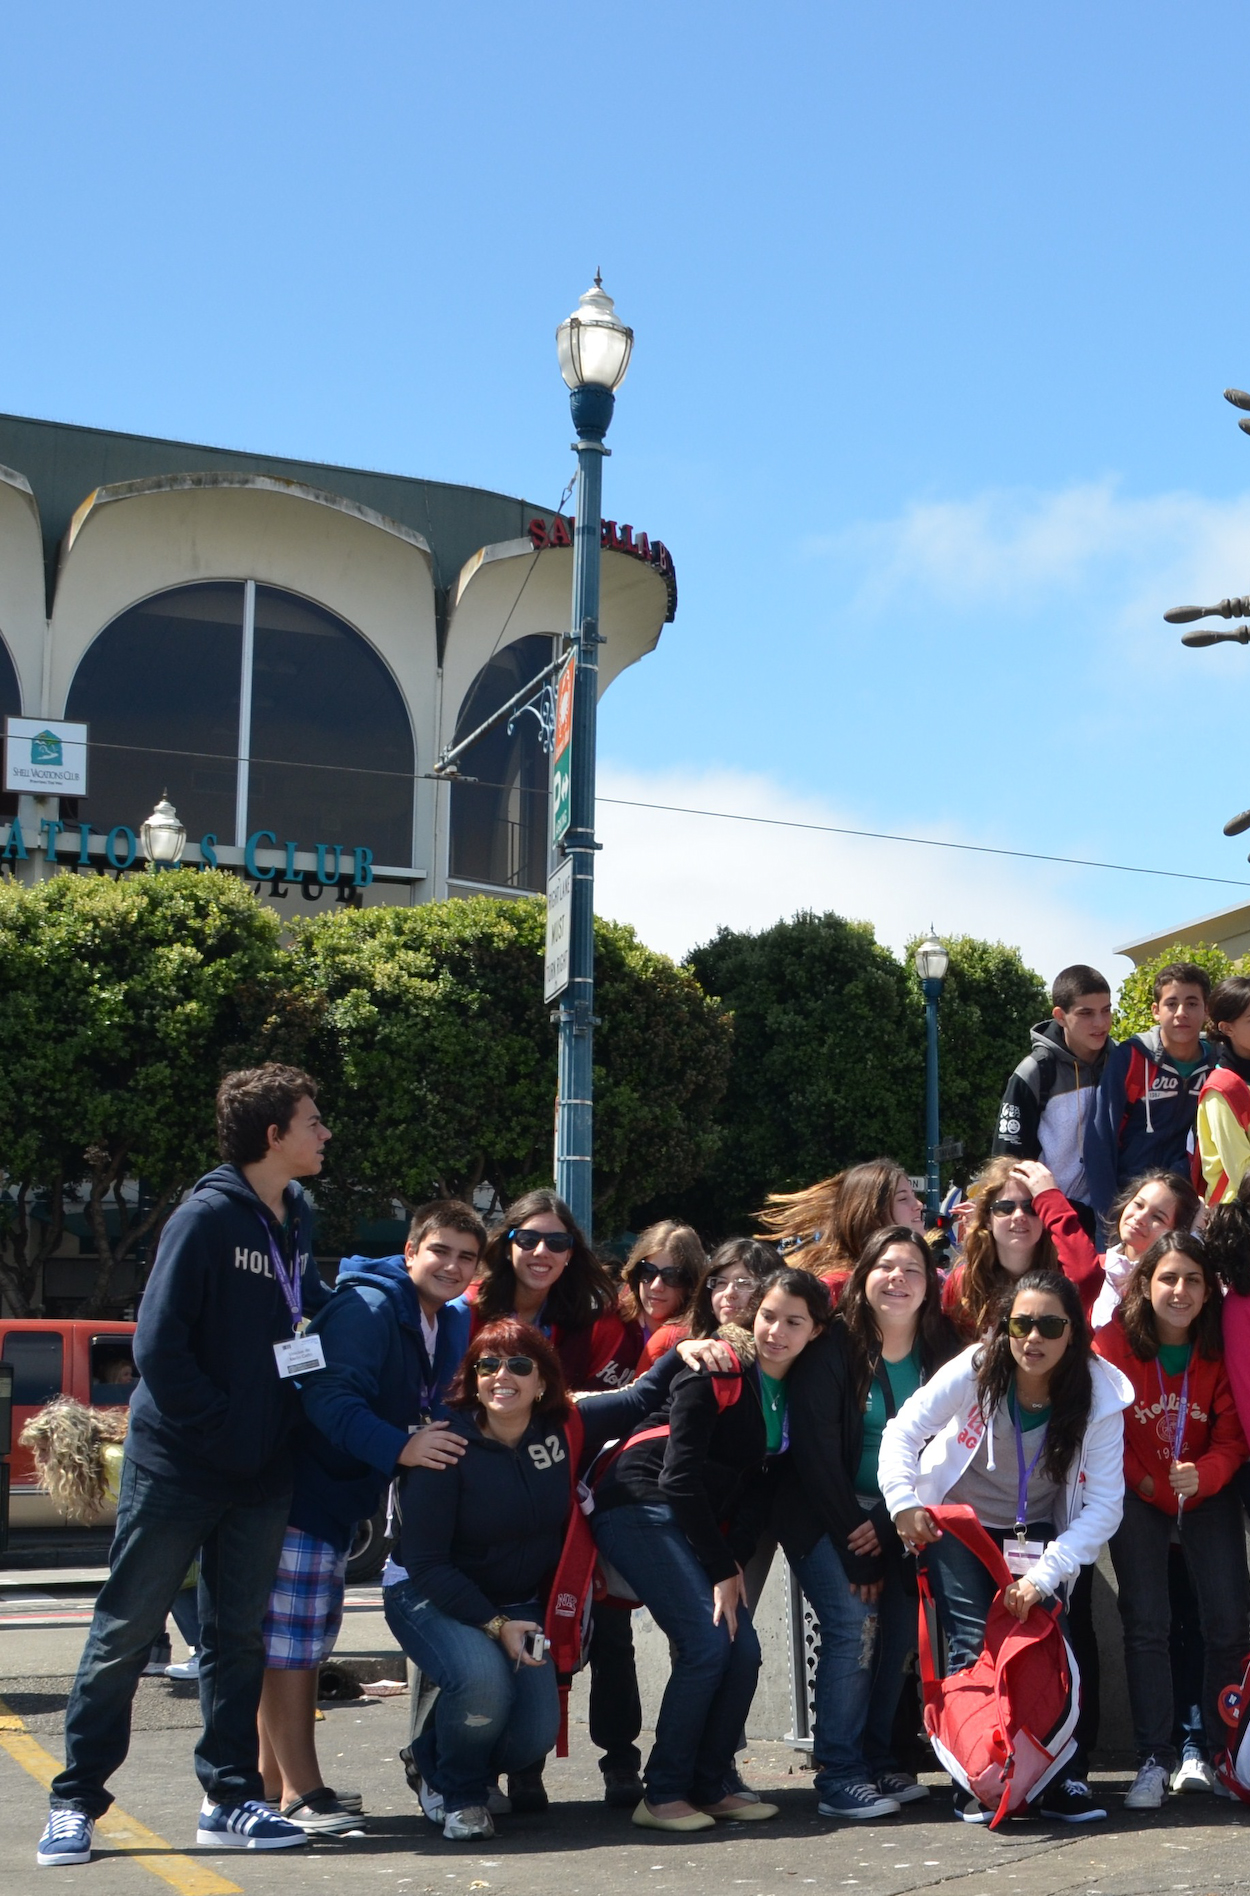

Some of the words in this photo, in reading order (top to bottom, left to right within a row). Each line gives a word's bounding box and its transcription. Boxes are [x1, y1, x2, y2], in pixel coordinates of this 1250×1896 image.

[12, 766, 31, 778] SHELL
[2, 816, 217, 872] ATIOS
[244, 830, 374, 888] CLUB
[551, 913, 565, 946] MUST
[527, 1434, 566, 1470] 92
